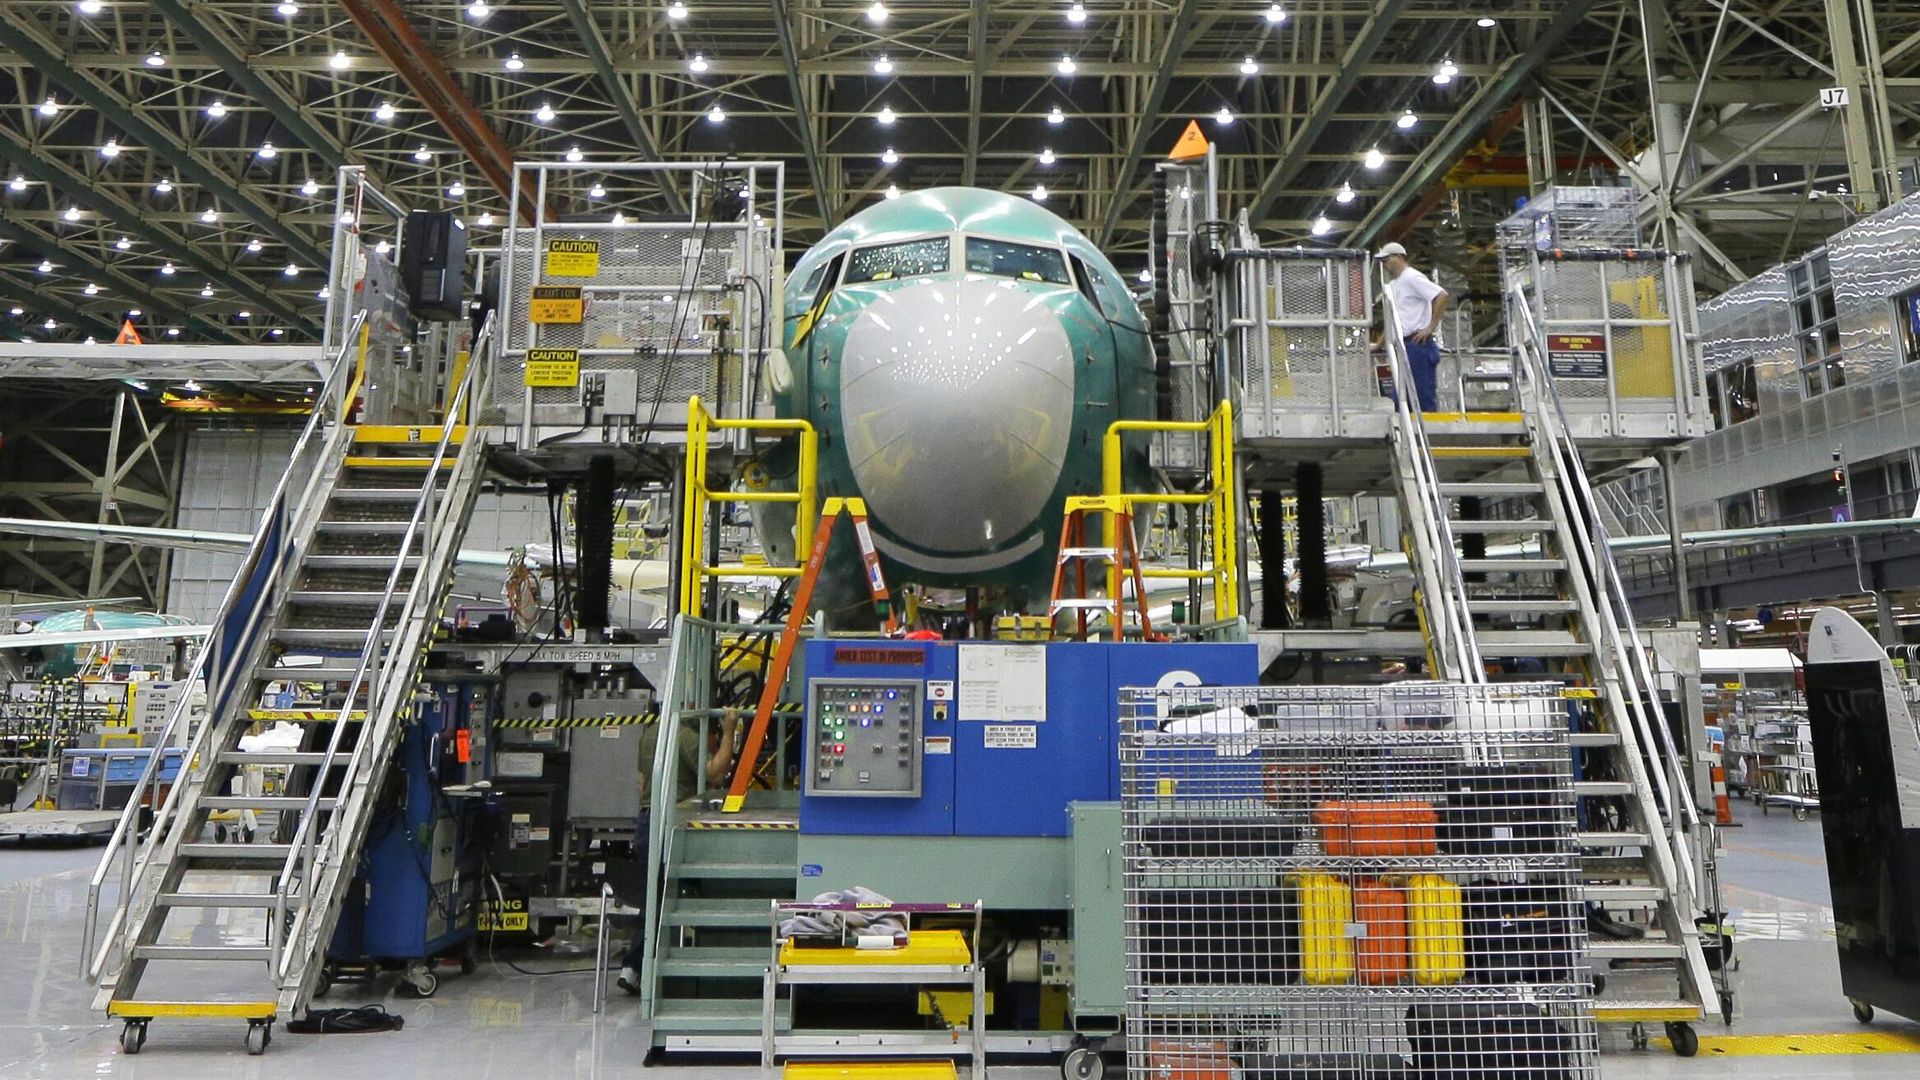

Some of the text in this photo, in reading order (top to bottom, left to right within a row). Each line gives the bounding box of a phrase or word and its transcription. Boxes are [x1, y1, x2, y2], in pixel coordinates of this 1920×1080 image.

[1823, 89, 1844, 104] J7
[552, 241, 596, 252] CAUTION
[537, 289, 577, 298] CAUTION
[531, 351, 574, 361] CAUTION
[529, 652, 545, 660] MAX
[550, 651, 565, 660] TOW
[569, 651, 593, 660] SPEED
[604, 651, 620, 660] MPH
[505, 917, 524, 927] ONLY
